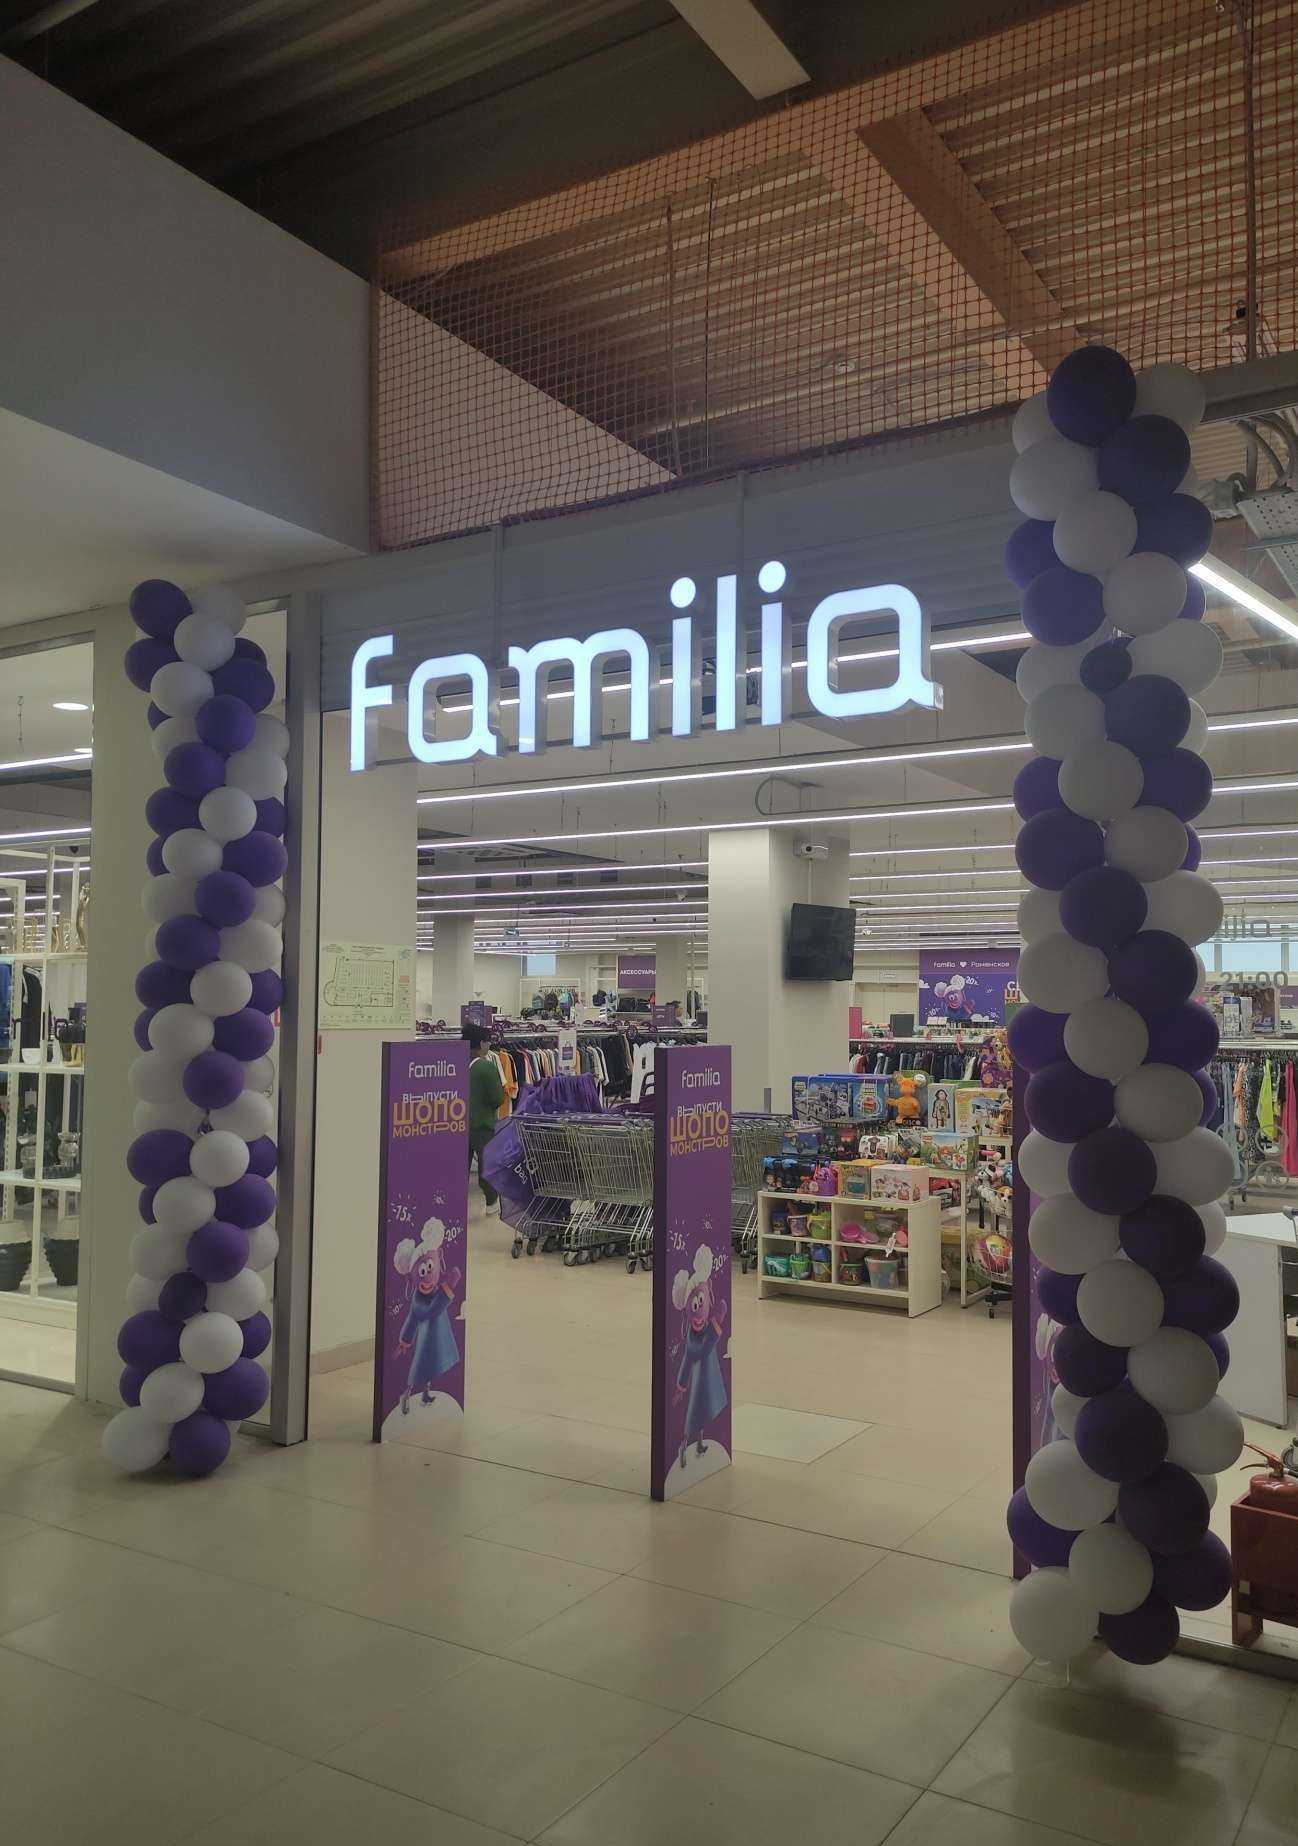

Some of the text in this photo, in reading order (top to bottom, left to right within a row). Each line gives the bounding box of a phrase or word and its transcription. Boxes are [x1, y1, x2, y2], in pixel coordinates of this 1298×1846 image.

[350, 560, 943, 772] familia
[1220, 971, 1288, 989] 21:00
[408, 1060, 457, 1079] familia
[681, 1067, 721, 1089] familia
[402, 1090, 459, 1104] ВЫПУСТИ
[393, 1098, 466, 1126] ШОПО
[677, 1101, 722, 1118] ВЫПУСТИ
[392, 1120, 466, 1138] МОНСТРОВ
[670, 1110, 729, 1142] ШОПО
[670, 1135, 729, 1156] МОНСТРОВ
